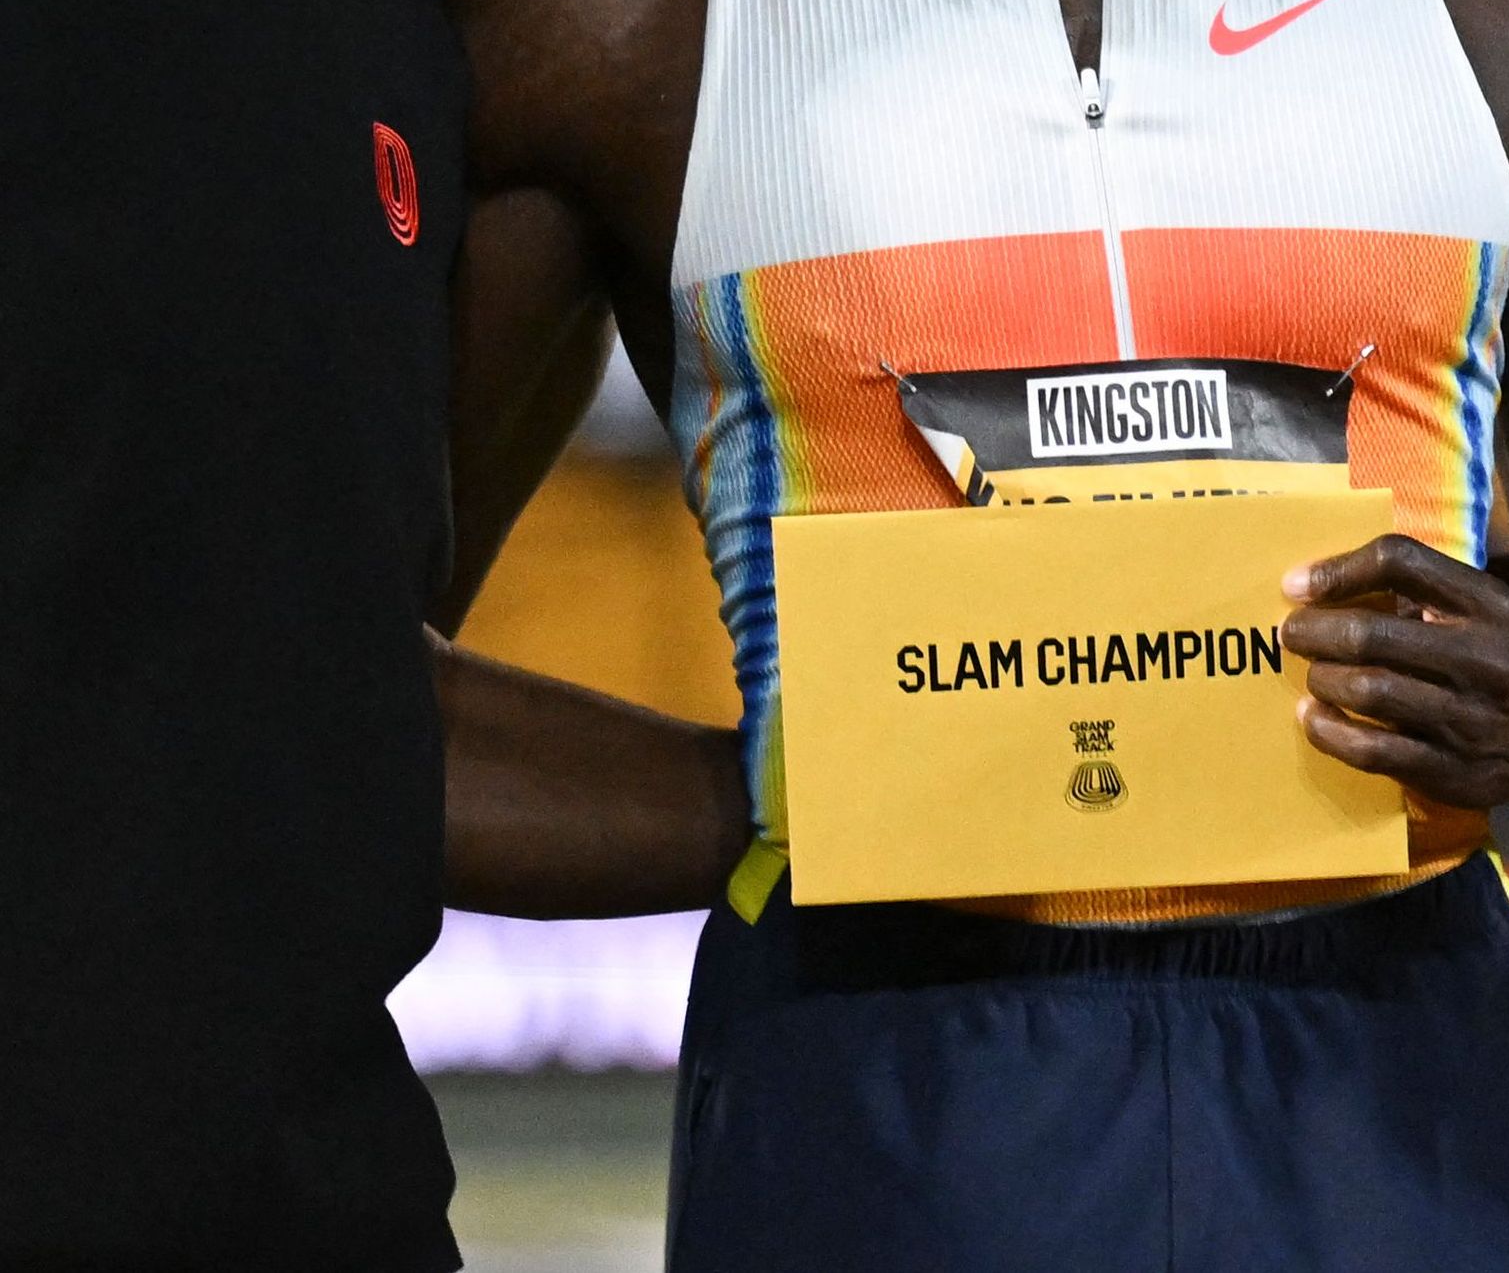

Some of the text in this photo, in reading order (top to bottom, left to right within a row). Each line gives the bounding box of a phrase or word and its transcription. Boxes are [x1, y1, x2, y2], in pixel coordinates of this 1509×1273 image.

[1038, 379, 1222, 447] KINGSTON
[897, 626, 1282, 694] SLAM CHAMPION
[1069, 719, 1115, 732] GRAND
